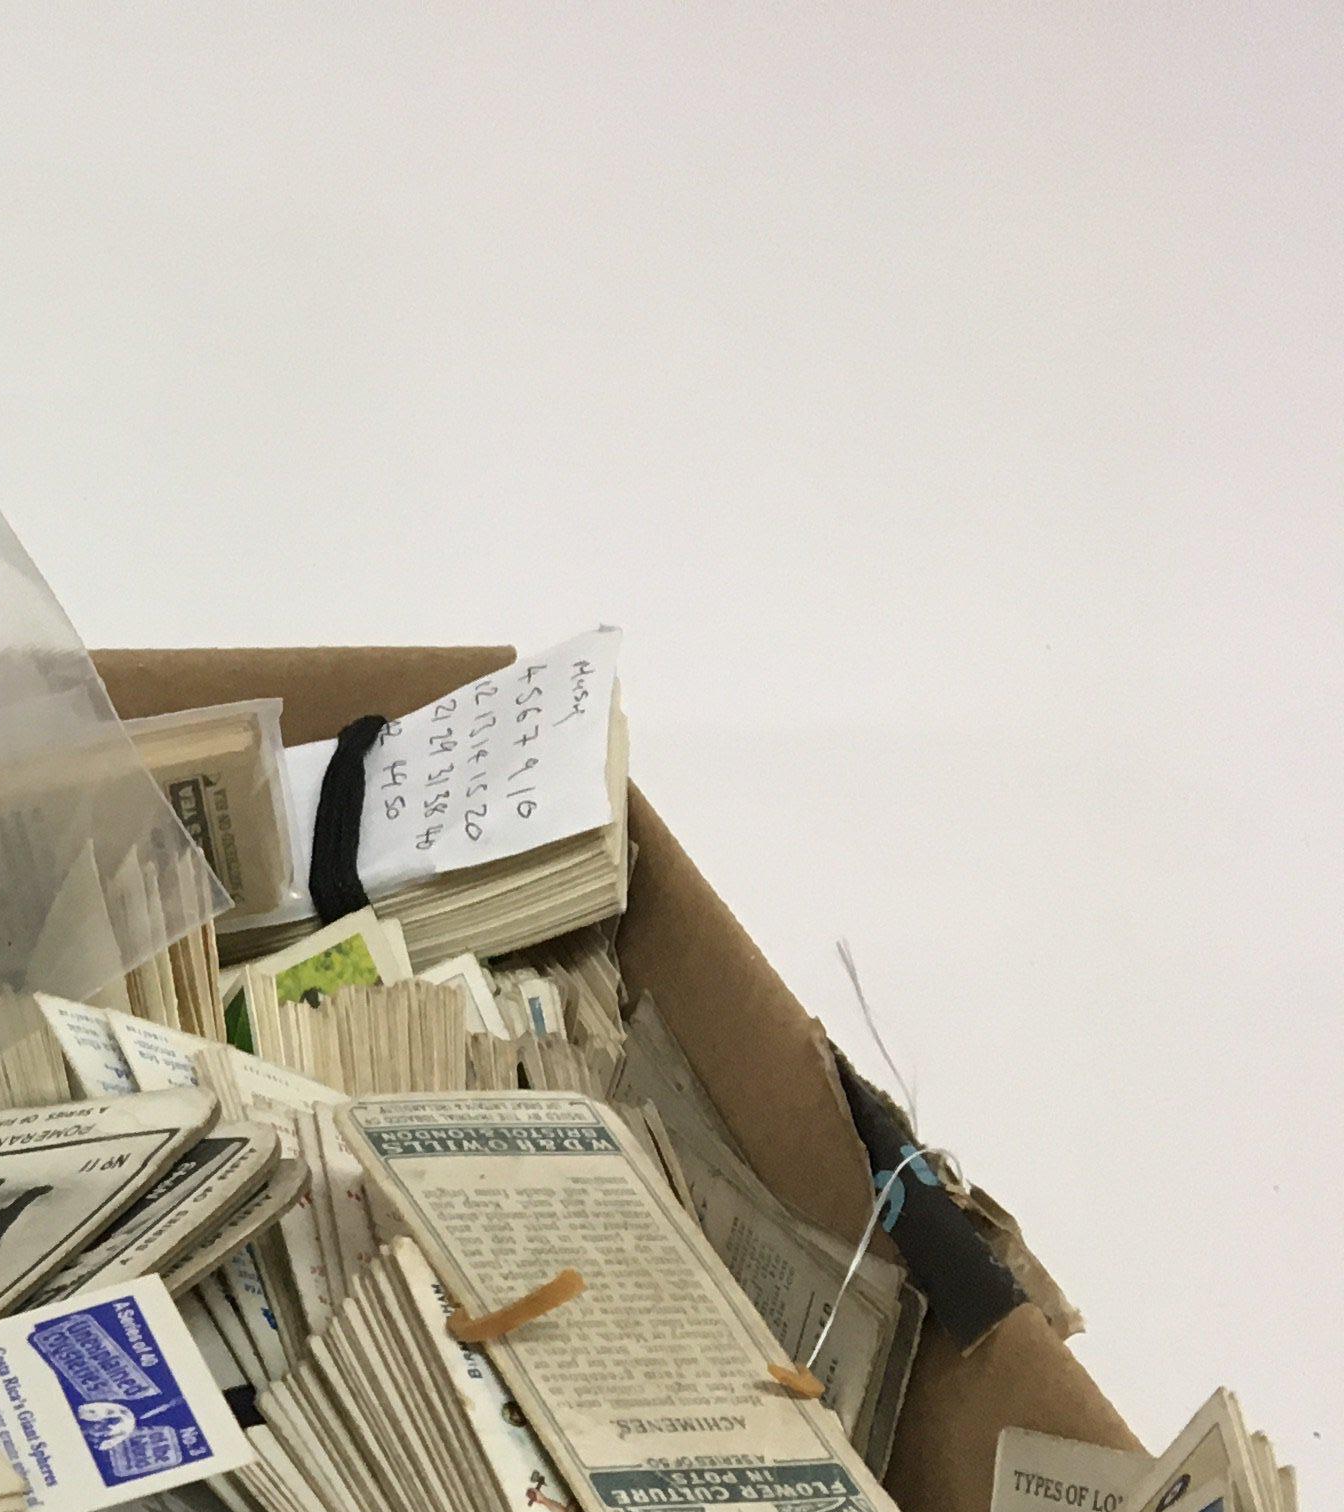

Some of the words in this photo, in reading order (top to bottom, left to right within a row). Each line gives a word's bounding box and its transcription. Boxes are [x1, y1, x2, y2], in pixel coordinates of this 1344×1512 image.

[472, 679, 499, 705] 12
[514, 705, 542, 723] 6
[510, 724, 541, 748] 7
[504, 756, 541, 781] 9
[383, 794, 407, 821] 50
[506, 786, 540, 821] 10
[461, 804, 492, 842] 20
[111, 1300, 126, 1311] A
[117, 1308, 145, 1345] Series
[65, 1318, 145, 1398] Unexplained
[132, 1339, 152, 1356] of
[138, 1350, 159, 1369] 40
[1, 1374, 27, 1411] Rica's
[15, 1407, 42, 1443] Giant
[178, 1424, 201, 1448] No.
[188, 1444, 206, 1458] 3
[25, 1439, 62, 1491] Spheres
[672, 1470, 738, 1484] POTS
[745, 1469, 771, 1481] IN
[611, 1485, 729, 1507] CULTURE
[738, 1480, 848, 1499] FLOWER
[1011, 1470, 1063, 1502] TYPES
[1065, 1484, 1089, 1507] OF
